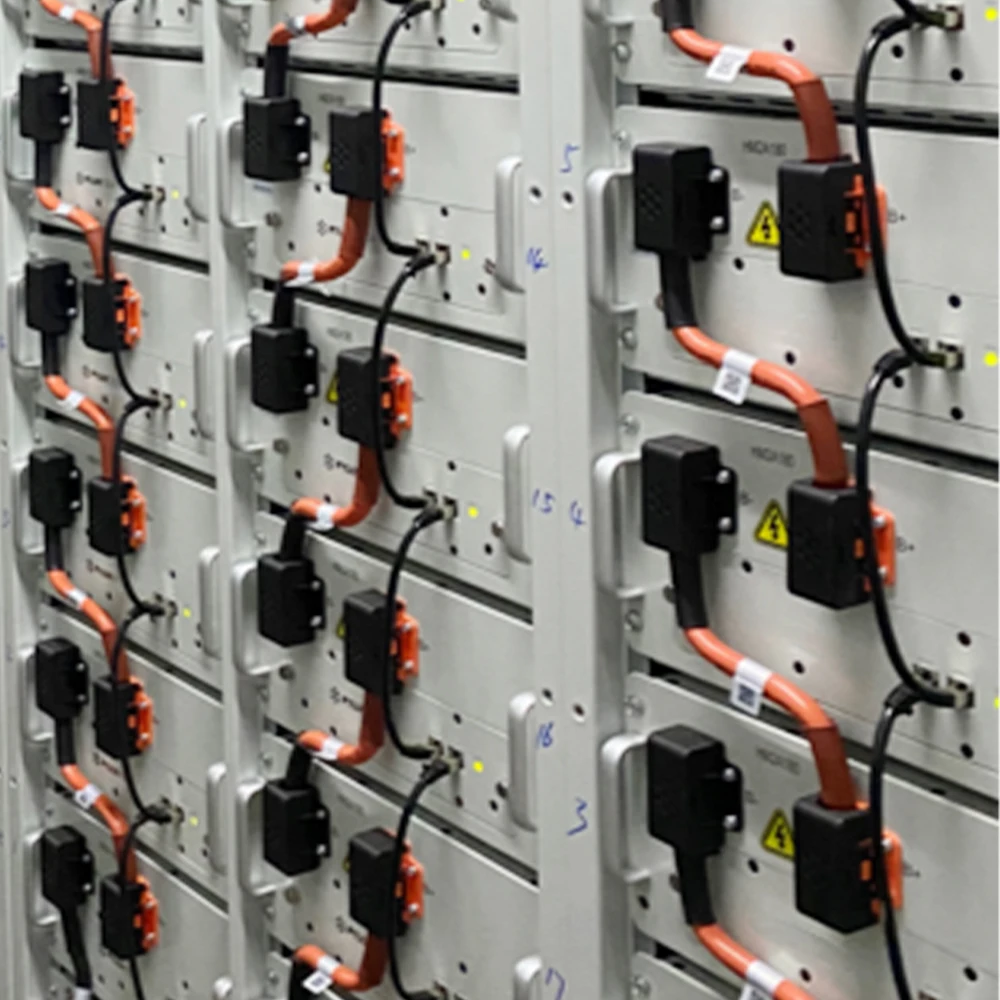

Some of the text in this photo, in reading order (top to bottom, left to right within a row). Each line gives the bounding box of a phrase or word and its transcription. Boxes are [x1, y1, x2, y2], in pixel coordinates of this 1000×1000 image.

[560, 144, 580, 173] 5
[532, 488, 556, 514] 15
[569, 500, 588, 530] 4
[567, 797, 588, 835] 3
